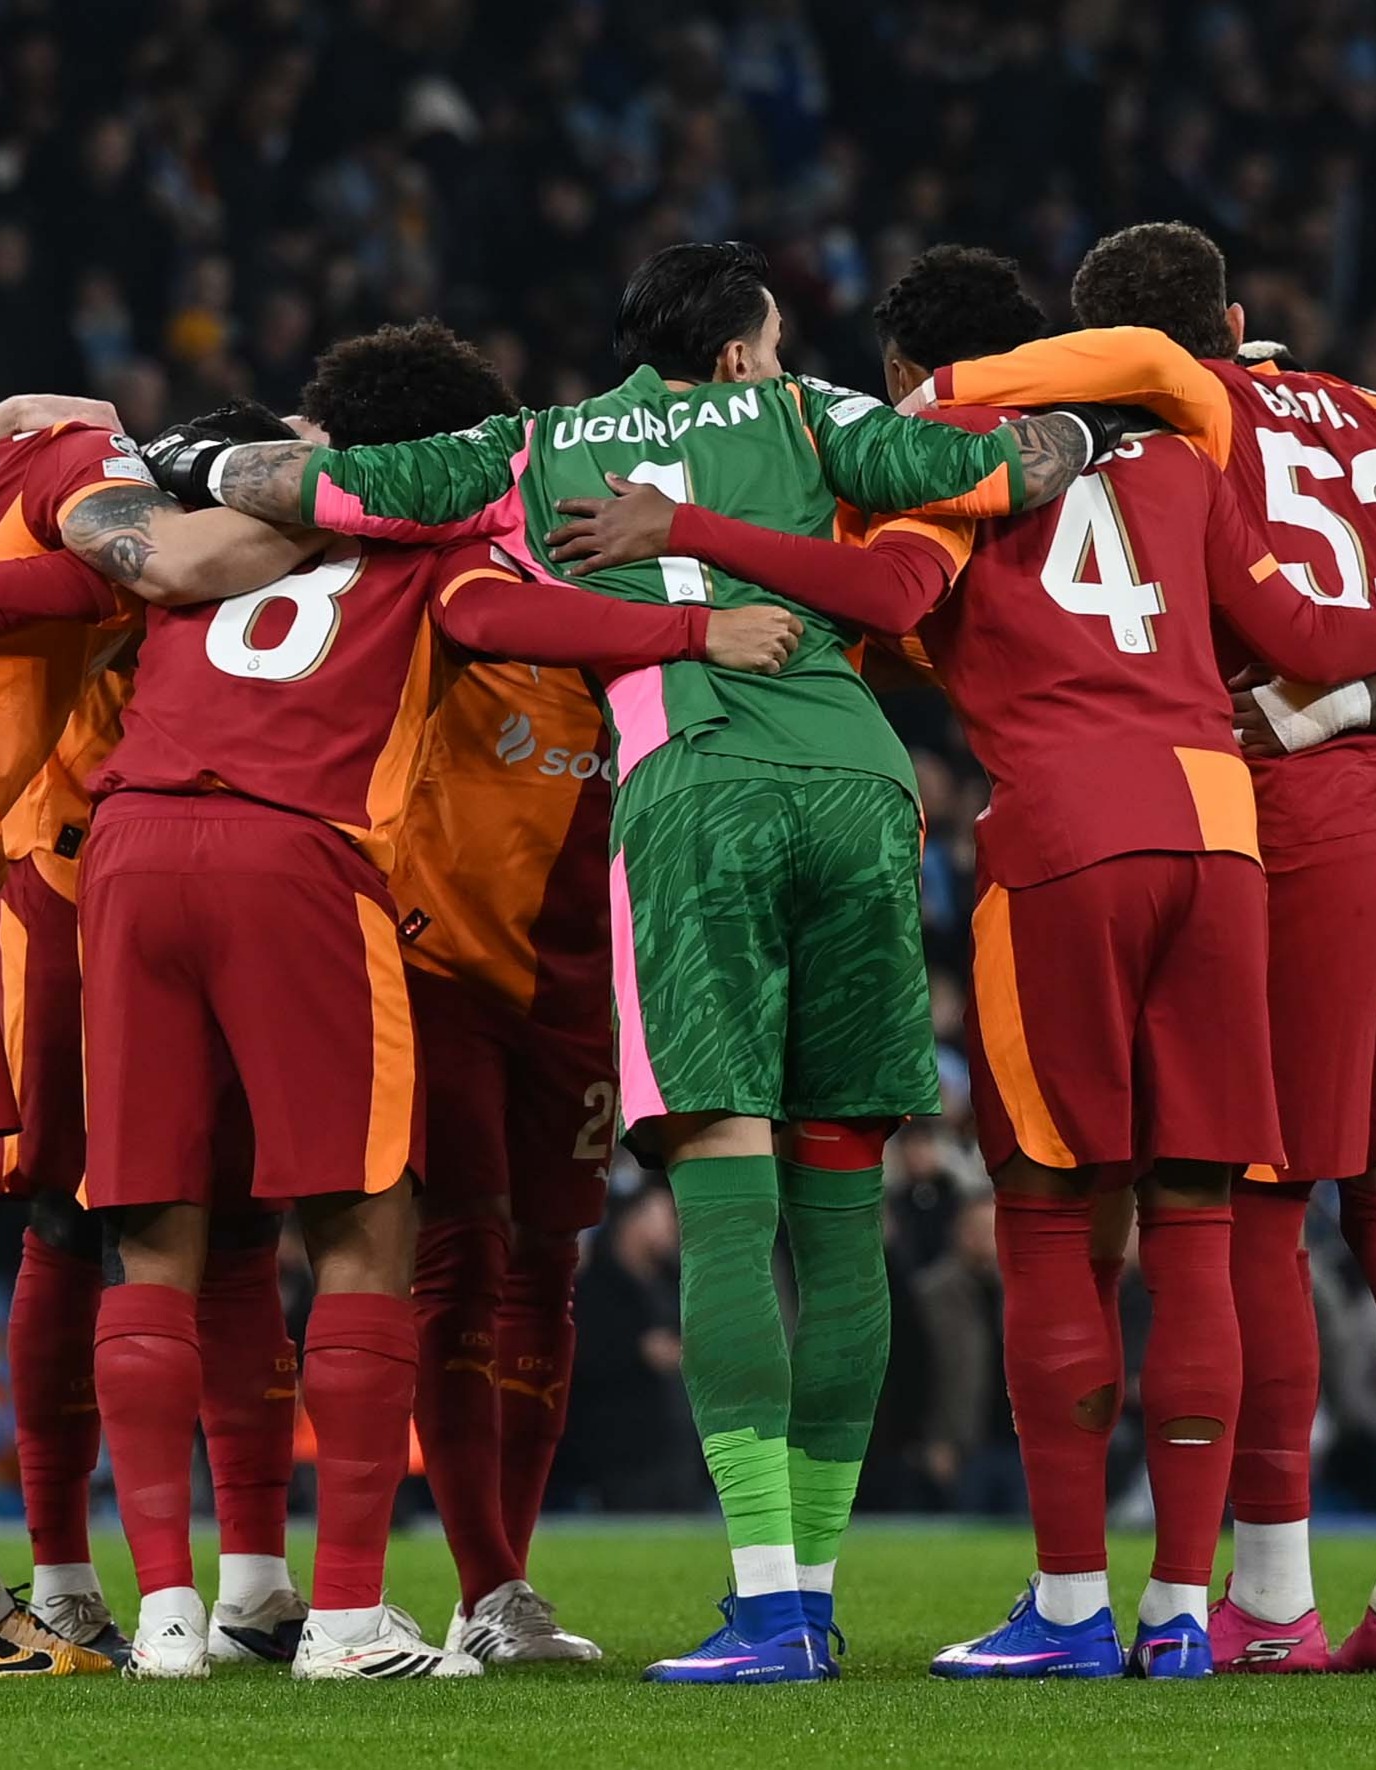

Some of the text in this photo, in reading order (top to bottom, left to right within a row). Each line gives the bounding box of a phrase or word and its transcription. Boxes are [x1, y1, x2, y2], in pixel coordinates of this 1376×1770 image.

[553, 387, 760, 450] UGURCAN
[205, 546, 367, 682] 8
[1040, 471, 1167, 654] 4
